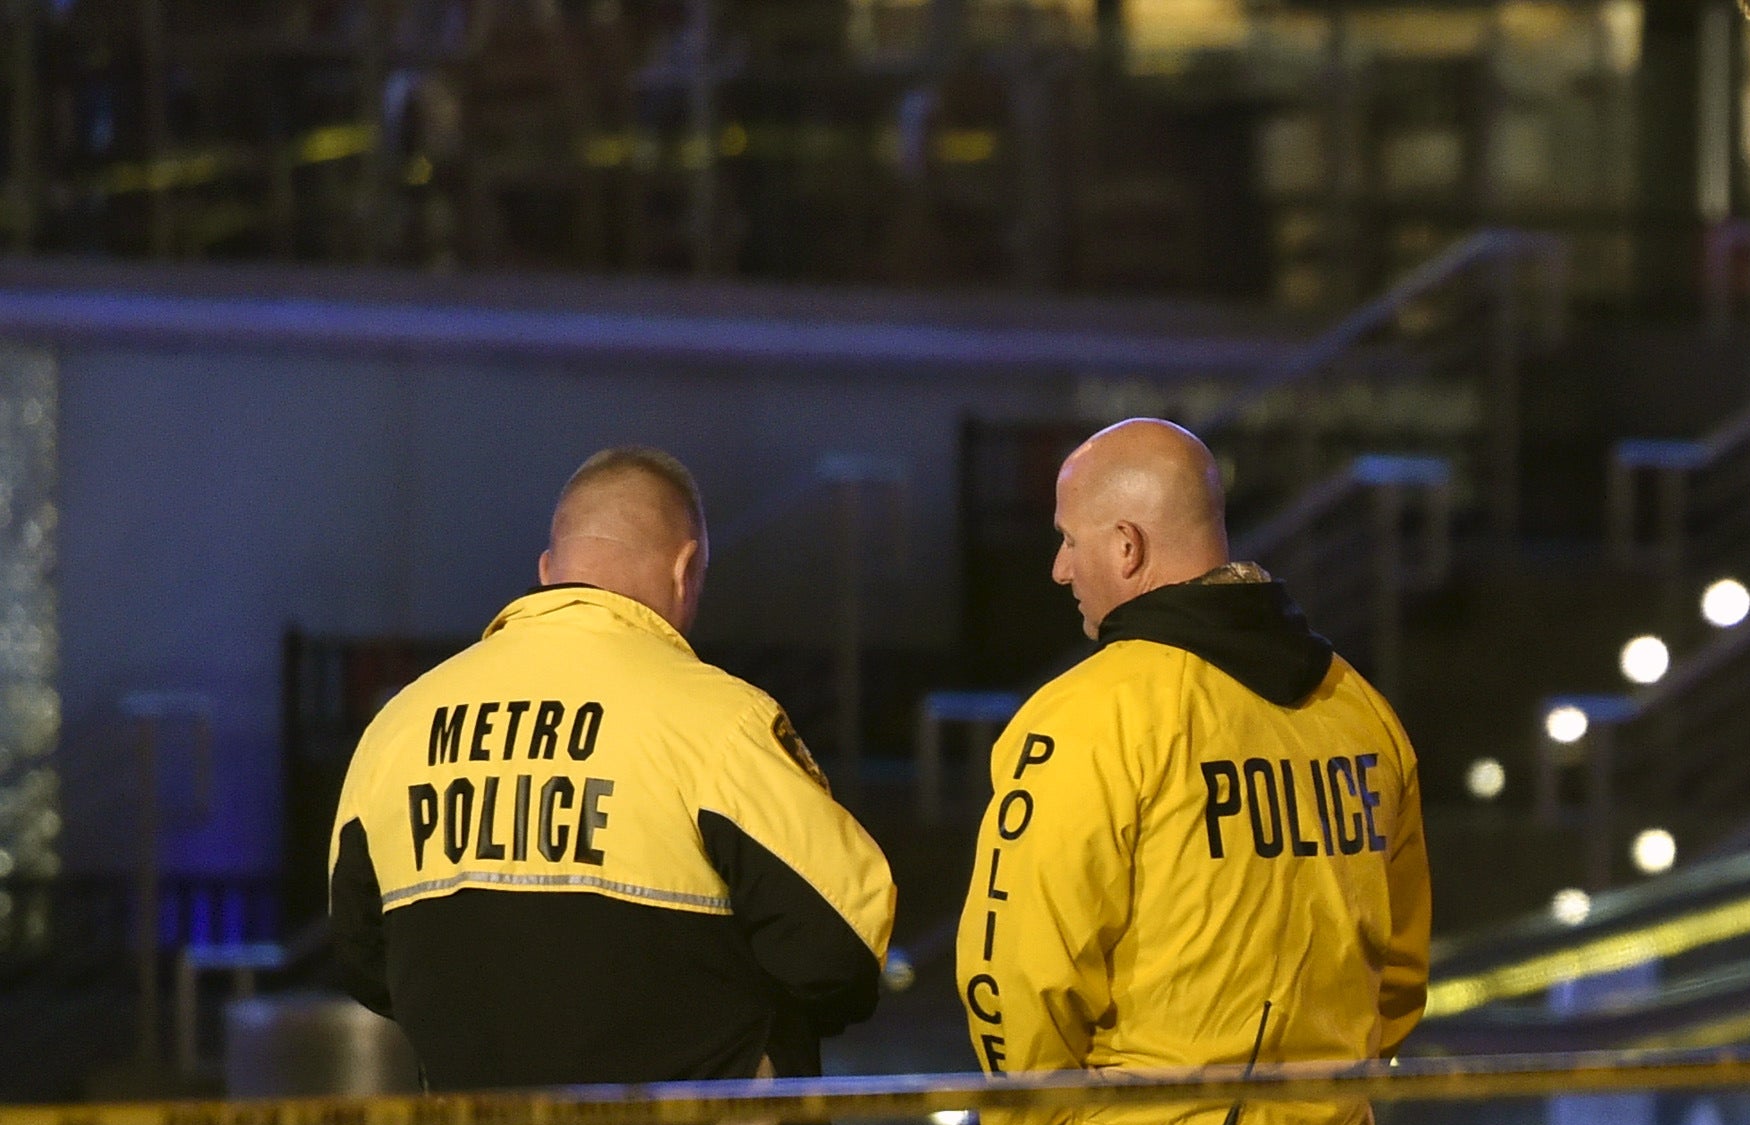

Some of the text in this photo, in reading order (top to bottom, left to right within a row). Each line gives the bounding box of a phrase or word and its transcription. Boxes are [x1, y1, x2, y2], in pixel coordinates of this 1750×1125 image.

[428, 700, 604, 767] METRO
[408, 774, 615, 872] POLICE
[1200, 752, 1387, 860] POLICE
[966, 732, 1055, 1079] POLICE
